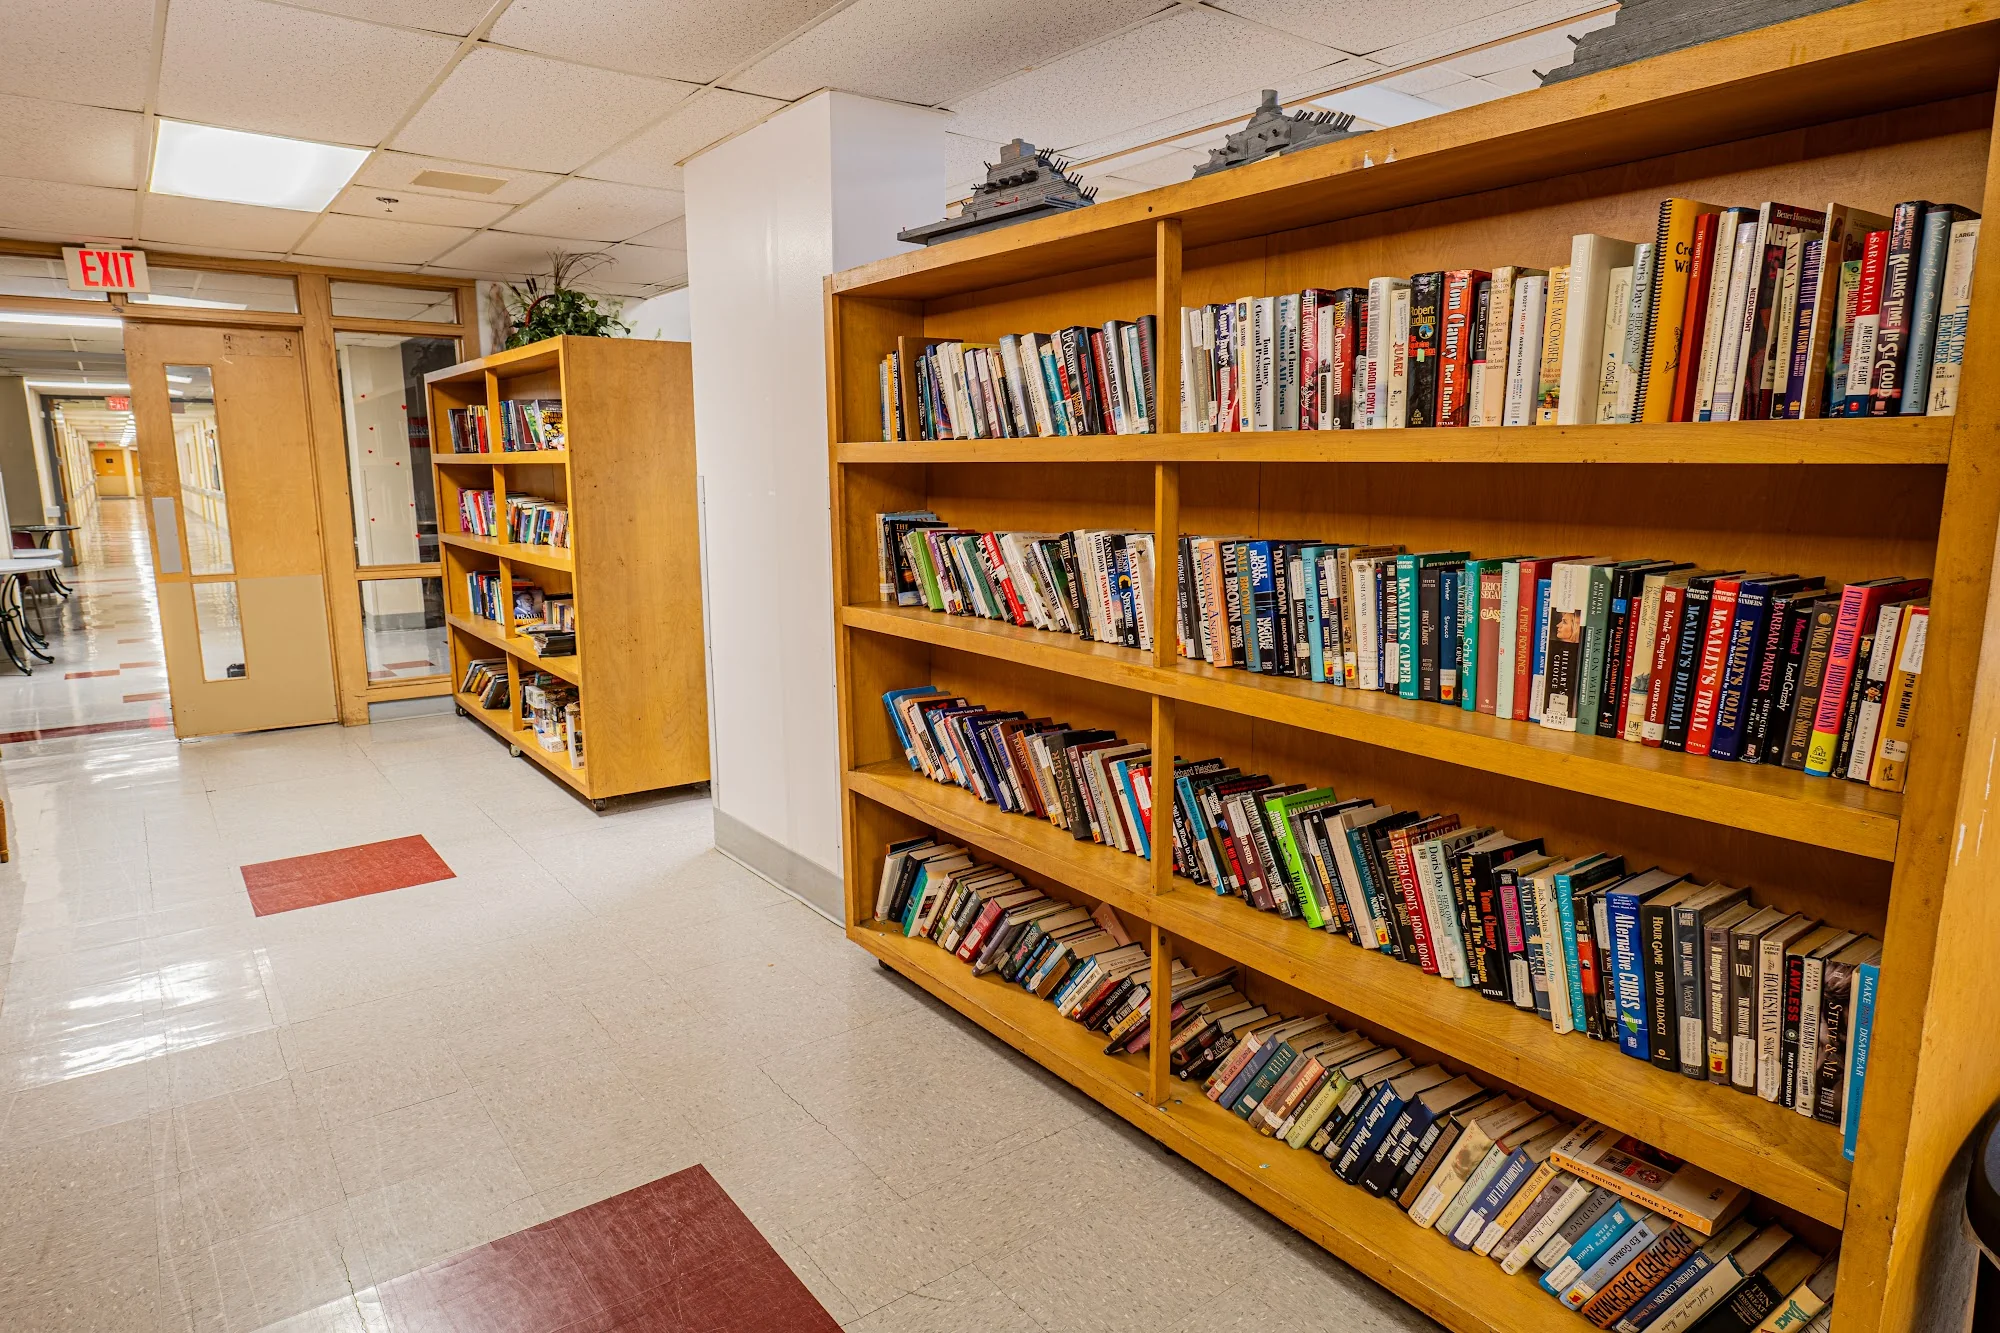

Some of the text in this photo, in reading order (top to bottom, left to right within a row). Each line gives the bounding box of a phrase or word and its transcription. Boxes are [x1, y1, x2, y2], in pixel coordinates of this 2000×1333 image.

[78, 250, 135, 288] EXIT
[1634, 250, 1651, 309] Doris Day:
[1784, 241, 1799, 290] NANCY
[1861, 237, 1879, 312] SARAH PALIN
[1889, 253, 1910, 299] KILLING
[1280, 299, 1288, 322] The
[1442, 278, 1468, 360] Tom Clancy
[1547, 272, 1567, 365] DEBBIE MACOMBER
[1627, 312, 1635, 341] STORY
[1744, 288, 1757, 333] NEEDLEPOINT
[1884, 299, 1904, 326] TIME
[1062, 329, 1076, 375] UP COUNTRY
[1104, 324, 1112, 345] SUE
[1279, 325, 1287, 350] Sum
[1880, 329, 1898, 342] IN
[1935, 315, 1953, 364] REMEMBER
[1107, 348, 1119, 401] GRAFTON
[1262, 338, 1270, 386] Tom Clancy
[1280, 352, 1287, 362] of
[1287, 327, 1296, 386] Tom Clancy
[1857, 326, 1873, 385] AMERICA BY HEART
[1279, 384, 1287, 414] Fears
[1366, 362, 1376, 415] HAROLD COYLE
[1442, 364, 1455, 420] Red Rabbit
[1875, 359, 1895, 398] CLOUD
[1254, 384, 1262, 416] Danger
[1104, 536, 1117, 596] FANNIE FLAGG
[1222, 544, 1240, 622] DALE BROWN
[1250, 550, 1260, 586] BROWN
[1258, 554, 1268, 579] DALE
[1273, 550, 1286, 615] DALE BROWN
[1128, 552, 1147, 641] McNALLY'S GAMBLE
[1202, 551, 1218, 654] ARMCHAIR ANGLER
[1319, 579, 1328, 595] WILD
[1320, 596, 1330, 619] BUNCH
[1386, 581, 1397, 594] DAY
[1738, 597, 1763, 606] SANDERS
[1740, 591, 1764, 601] Lawrence
[1263, 617, 1272, 639] NIGHT
[1387, 605, 1397, 629] WRATH
[1398, 577, 1411, 684] McNALLY'S CAPER
[1519, 614, 1528, 632] FINE
[1840, 591, 1863, 629] CURRENT
[1235, 625, 1244, 648] WINGS
[1256, 618, 1264, 650] HAWK
[1656, 609, 1675, 670] Uncle Tungsten
[1758, 602, 1786, 691] BARBARA PARKER
[1790, 619, 1806, 655] Manfred
[1833, 629, 1854, 660] AFFAIRS
[1463, 638, 1473, 676] Schuller
[1518, 635, 1527, 675] ROMANCE
[1552, 654, 1560, 689] CHOICE
[1561, 650, 1569, 696] HILLARY'S
[1588, 628, 1602, 706] WALK ON WATER
[1669, 605, 1700, 730] McNALLY'S DILEMMA
[1692, 608, 1728, 732] McNALLY'S TRIAL
[1723, 619, 1754, 730] McNALLY'S FOLLY
[1804, 626, 1832, 688] NORA ROBERTS
[1779, 662, 1798, 712] Lord Grizzly
[1824, 663, 1847, 701] BARBARA
[1758, 699, 1770, 738] SUSPICION
[1792, 696, 1817, 748] BLUE SMOKE
[1818, 702, 1839, 730] RASKIN
[1011, 737, 1030, 771] JOURNEY
[1429, 846, 1443, 892] Doris Day:
[1461, 857, 1474, 876] The
[1291, 870, 1308, 905] TWISTED
[1393, 839, 1431, 967] STEPHEN COONTS HONG KONG
[1464, 877, 1477, 902] Bear
[1521, 884, 1535, 927] WILDER
[1558, 879, 1570, 918] LUANNE
[1469, 904, 1479, 920] and
[1480, 891, 1496, 950] Tom Clancy
[1503, 889, 1520, 947] Olivia Goldsmith
[1563, 921, 1573, 943] RICE
[1472, 922, 1483, 944] The
[1652, 916, 1663, 965] HOUR GAME
[1476, 947, 1488, 983] Dragon
[1615, 912, 1641, 1010] Alternative CURES
[1710, 954, 1722, 982] Hanging
[1654, 971, 1665, 1036] DAVID BALDACCI
[1763, 972, 1779, 1034] HOMESMAN
[1788, 960, 1802, 1023] LAWLESS
[1862, 975, 1873, 1005] MAKE
[1711, 992, 1723, 1035] Sweetwater
[1827, 1001, 1842, 1041] STEVE
[1822, 1055, 1838, 1080] ME
[1856, 1028, 1868, 1077] DISAPPEAR
[1781, 1051, 1794, 1106] MATT BONDURANT
[1339, 1088, 1396, 1173] Tom Clancy Debt of Honor
[1388, 1131, 1419, 1166] Tom Clancy
[1566, 1162, 1685, 1219] SELECT EDITIONS LARGE TYPE
[1570, 1192, 1611, 1234] SPENDING
[1608, 1235, 1642, 1267] ED GORMAN
[1633, 1226, 1692, 1282] RICHARD
[1584, 1270, 1644, 1328] BACHMAN
[1744, 1289, 1767, 1313] GREAT
[1752, 1284, 1773, 1309] TEN
